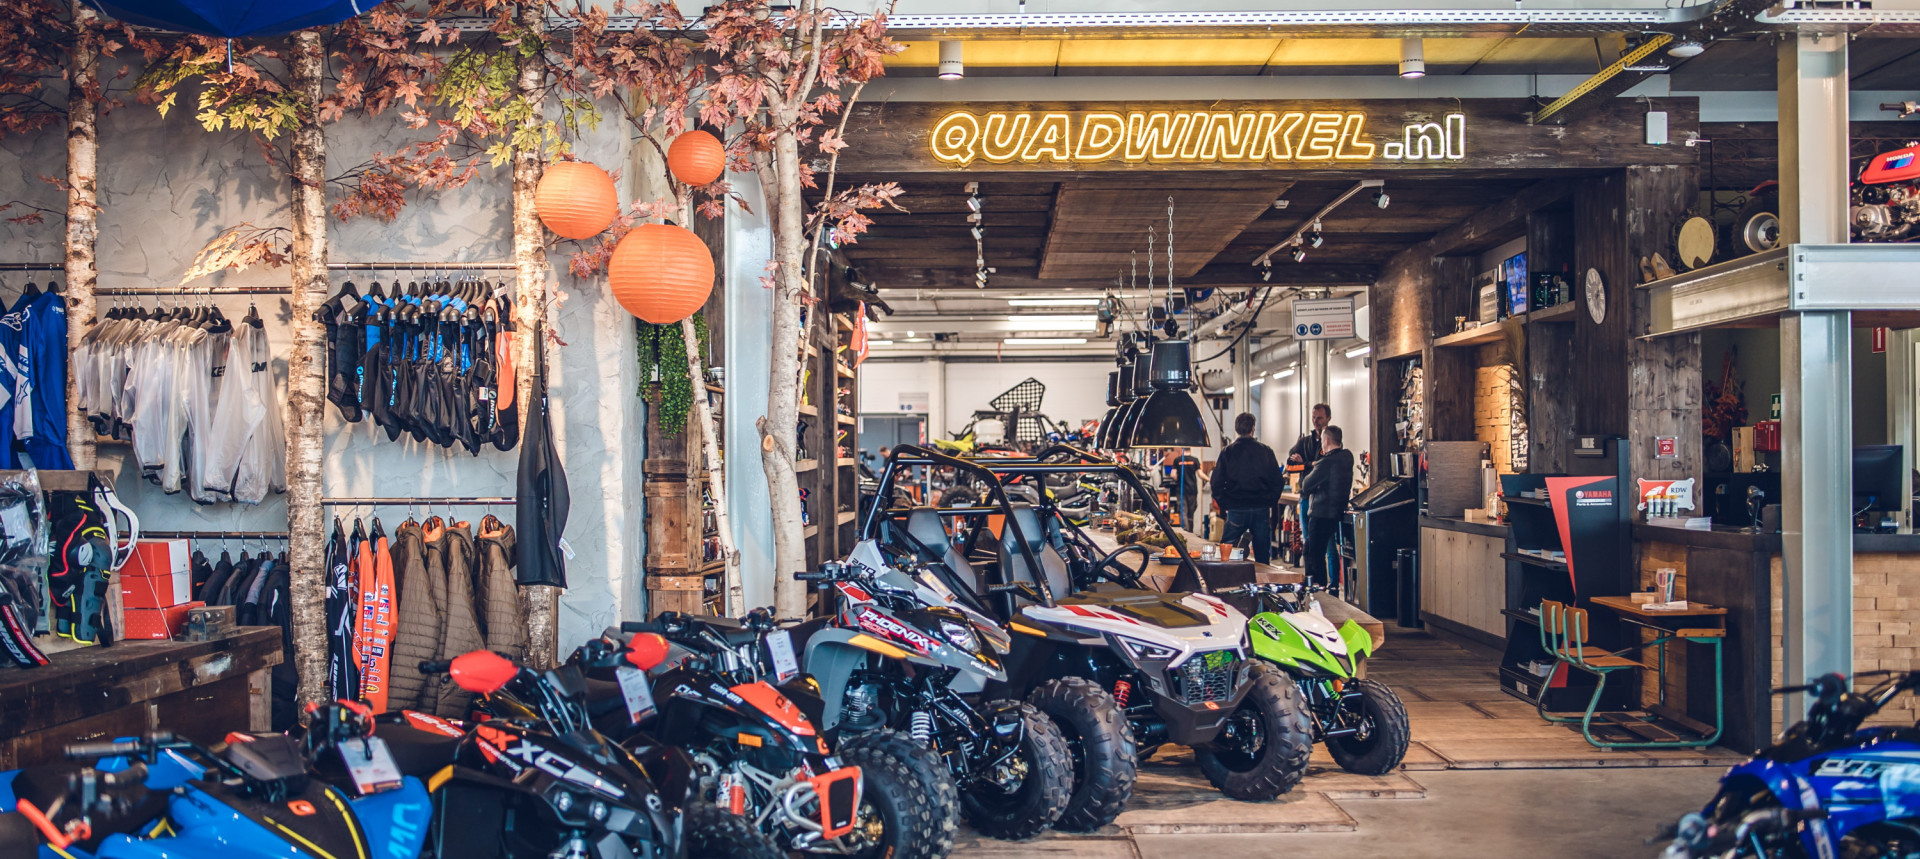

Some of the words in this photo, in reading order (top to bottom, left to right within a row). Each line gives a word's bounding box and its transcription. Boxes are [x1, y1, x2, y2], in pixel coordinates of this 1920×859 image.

[932, 113, 1465, 163] QUADWINKEL.nl
[1887, 152, 1914, 161] HONDA
[1584, 490, 1612, 498] YAMAHA
[860, 610, 927, 650] PHOENIX
[1257, 618, 1282, 636] KFX
